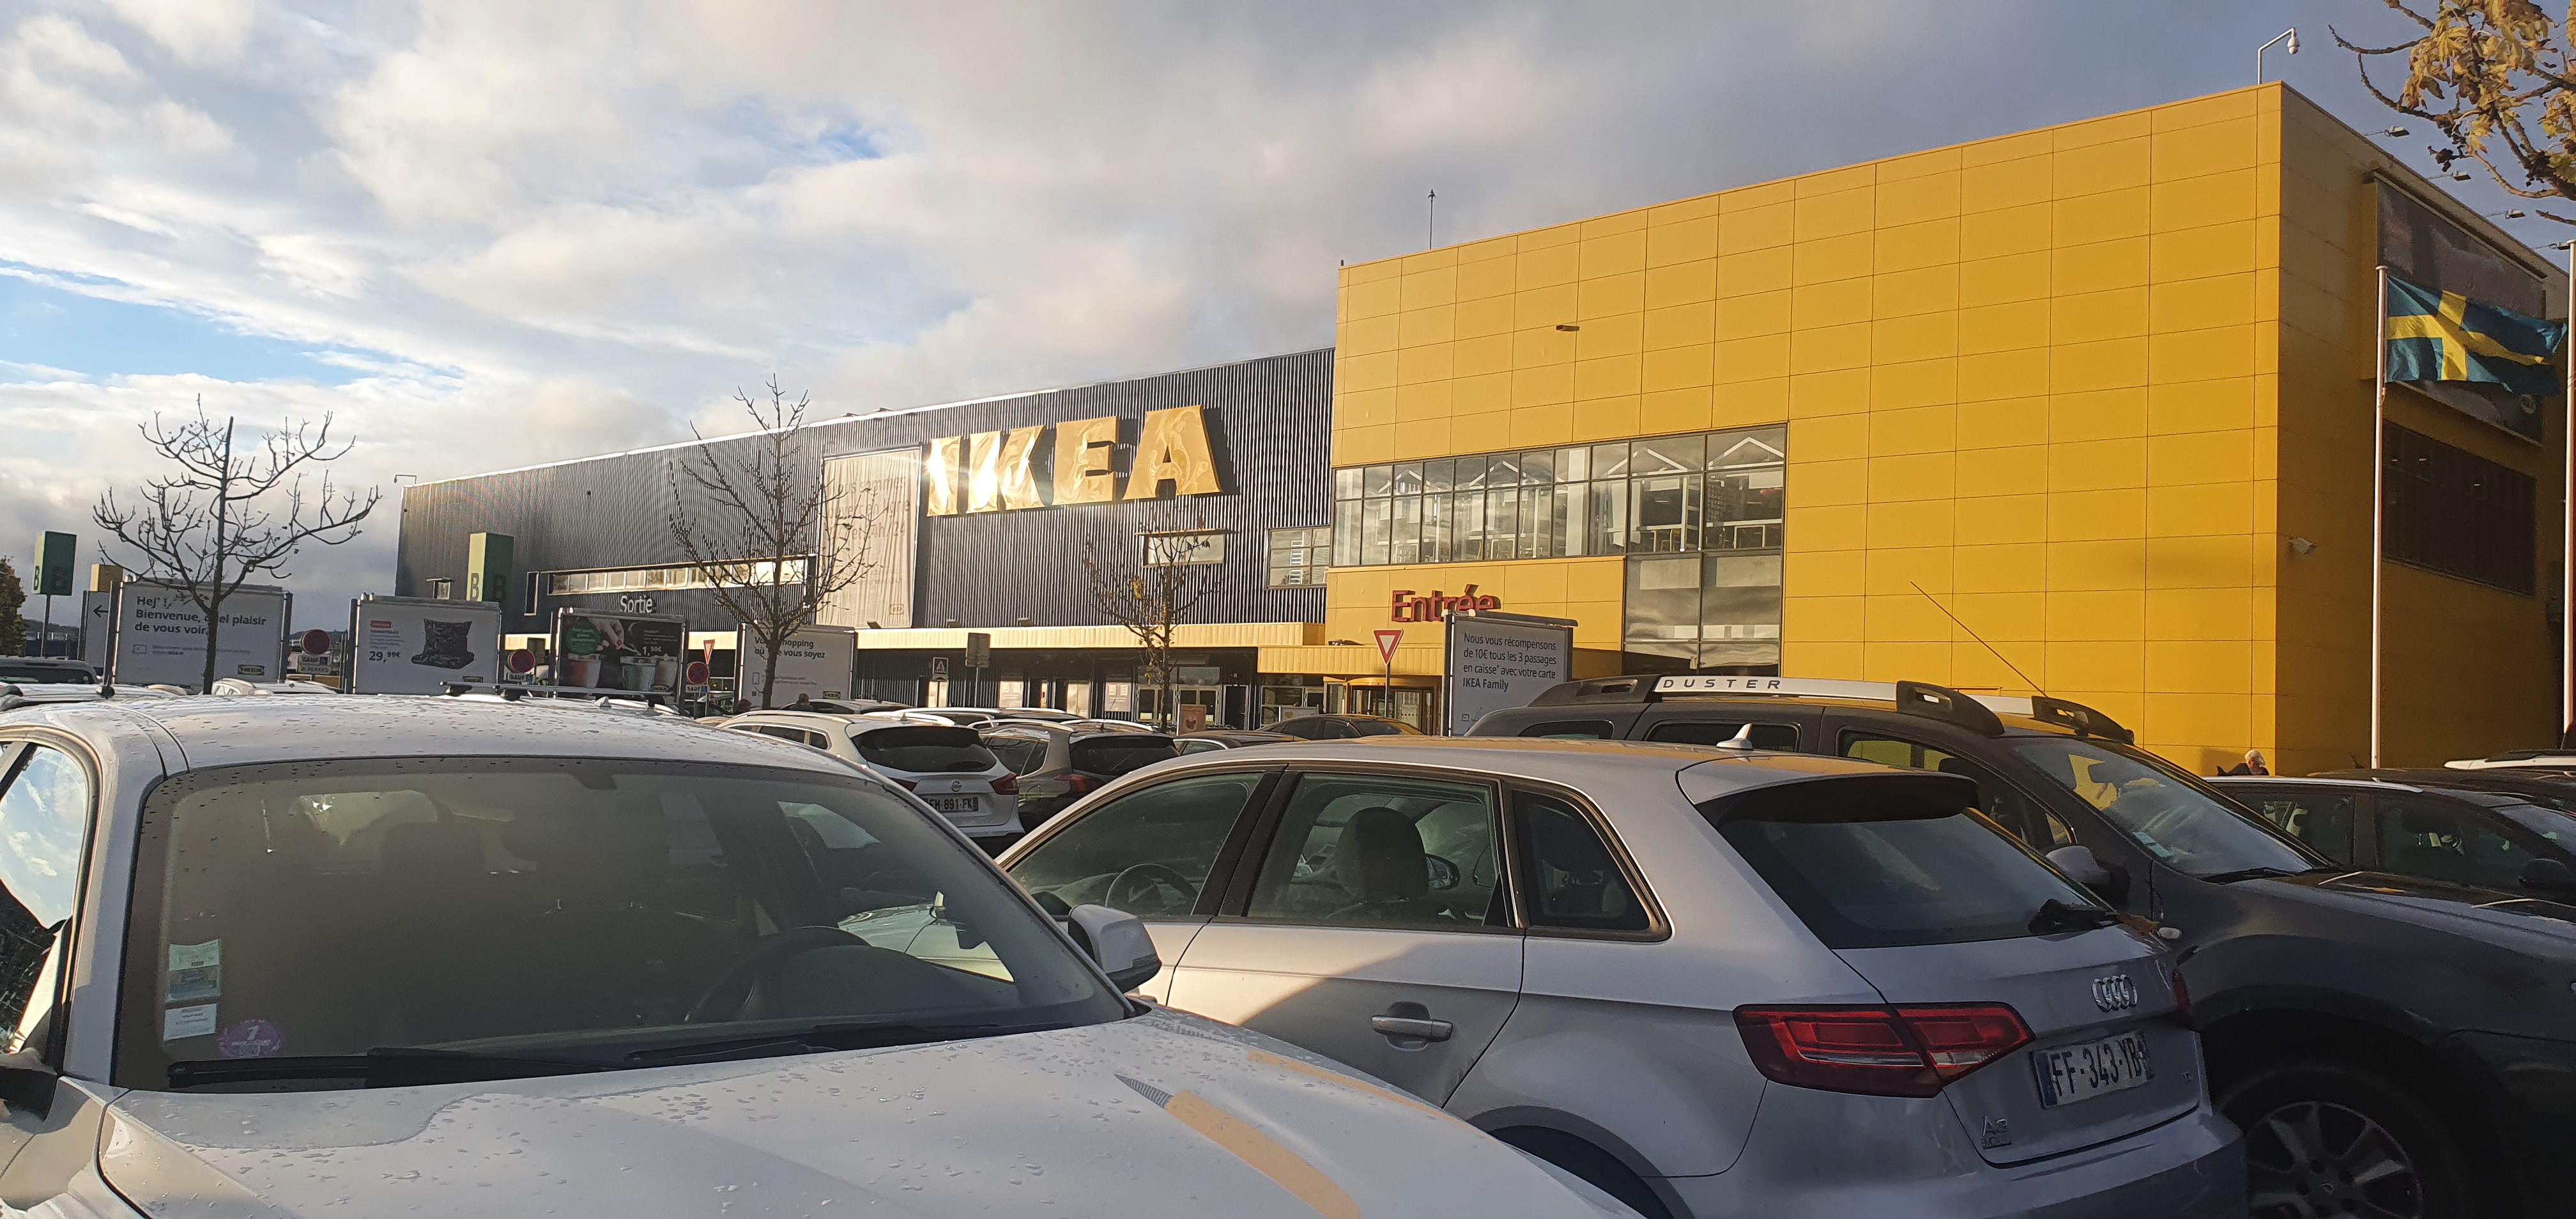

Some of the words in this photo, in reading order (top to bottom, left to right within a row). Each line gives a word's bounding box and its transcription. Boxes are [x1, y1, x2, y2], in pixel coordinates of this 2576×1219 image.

[927, 405, 1223, 516] IKEA
[34, 565, 40, 590] B
[470, 573, 479, 601] B
[493, 574, 507, 601] B
[620, 595, 653, 613] Sortie
[1392, 584, 1498, 622] Entrée
[135, 622, 150, 631] de
[153, 625, 181, 633] vous
[204, 614, 229, 623] qel
[232, 615, 267, 627] plaisir
[780, 638, 815, 649] hopping
[1464, 632, 1483, 644] Nous
[1485, 636, 1503, 646] vous
[1504, 636, 1556, 650] récompensons
[804, 651, 825, 659] soyez
[1464, 648, 1473, 658] de
[1475, 648, 1488, 659] 10€
[1489, 650, 1506, 661] tous
[1507, 650, 1517, 661] les
[1518, 652, 1523, 662] 3
[1524, 655, 1557, 667] passages
[1463, 664, 1473, 673] en
[1501, 667, 1517, 676] avec
[1519, 668, 1537, 677] votre
[1538, 670, 1556, 678] carte
[1462, 677, 1482, 687] IKEA
[1482, 678, 1509, 693] Family
[1662, 678, 1781, 689] DUSTER
[2050, 1037, 2143, 1097] FF-343-YB
